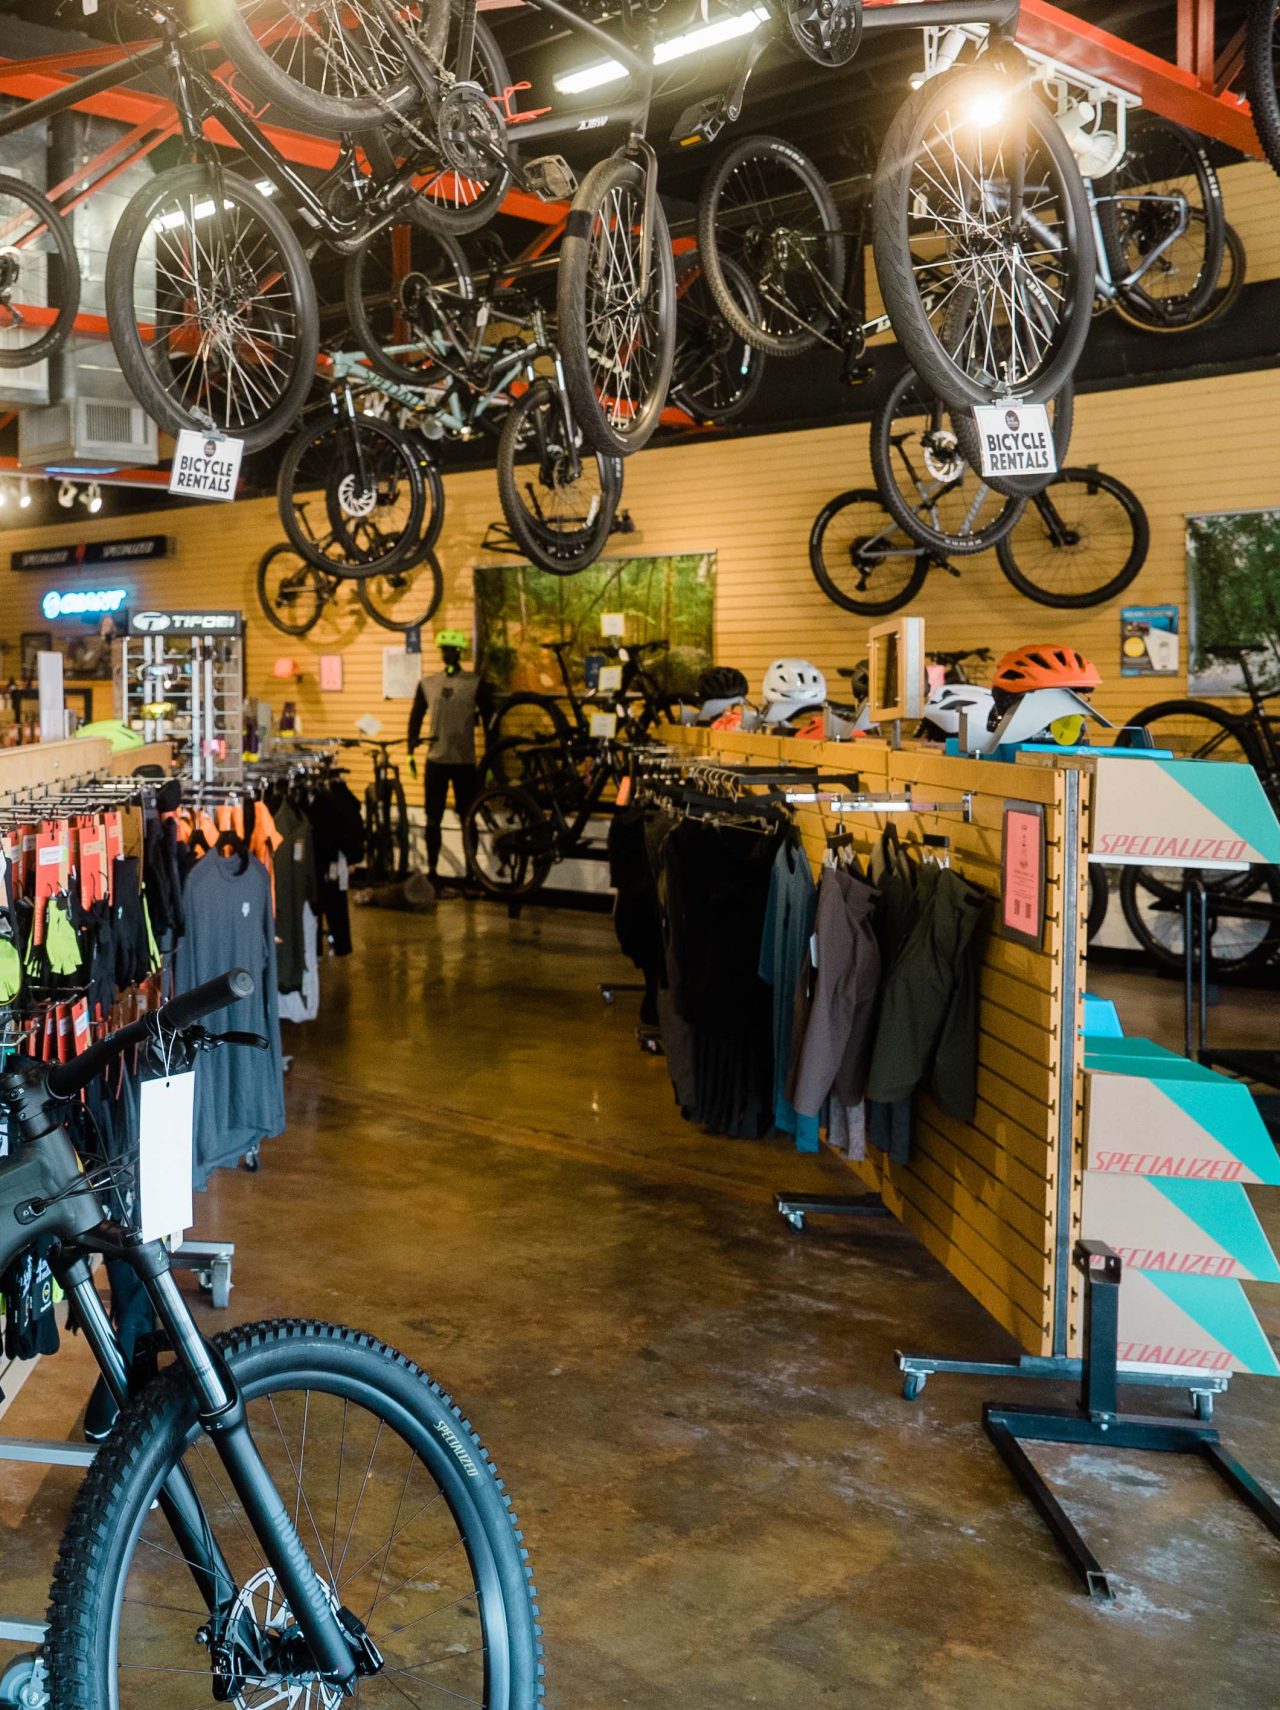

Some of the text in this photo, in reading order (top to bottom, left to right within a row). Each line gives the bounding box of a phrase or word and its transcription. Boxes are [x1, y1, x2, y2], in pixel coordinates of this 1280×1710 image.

[986, 432, 1047, 452] BICYCLE
[180, 455, 233, 477] BICYCLE
[989, 450, 1049, 471] RENTALS
[177, 472, 231, 493] RENTALS
[171, 615, 236, 629] TIFOSI
[1096, 833, 1248, 860] SPECIALIZED
[1089, 1151, 1244, 1180] SPECIALIZED
[1088, 1246, 1237, 1277] ECIALIZED
[432, 1420, 479, 1477] SPECIALIZED
